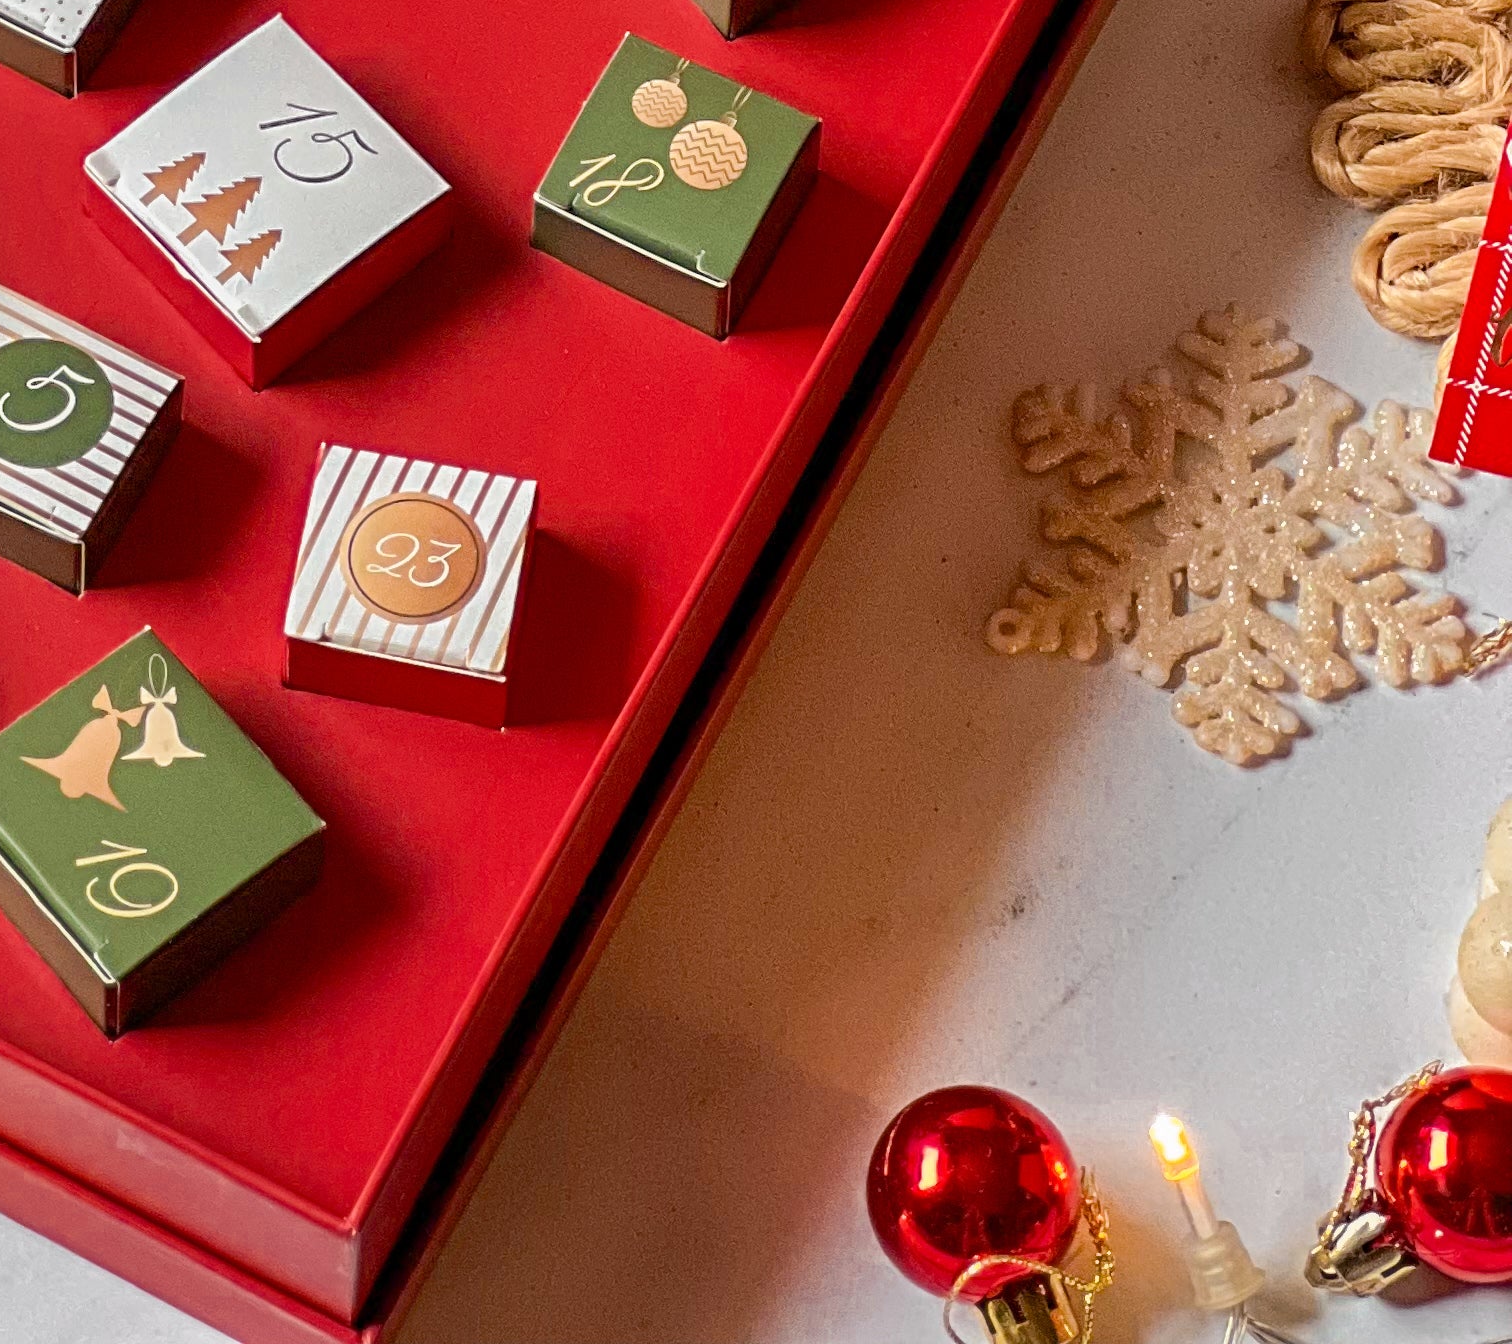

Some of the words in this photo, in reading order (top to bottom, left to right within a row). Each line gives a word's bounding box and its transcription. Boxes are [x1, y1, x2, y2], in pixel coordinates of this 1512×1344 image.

[259, 103, 378, 183] 15
[569, 153, 664, 207] 18
[367, 532, 462, 587] 23
[76, 839, 178, 917] 19
